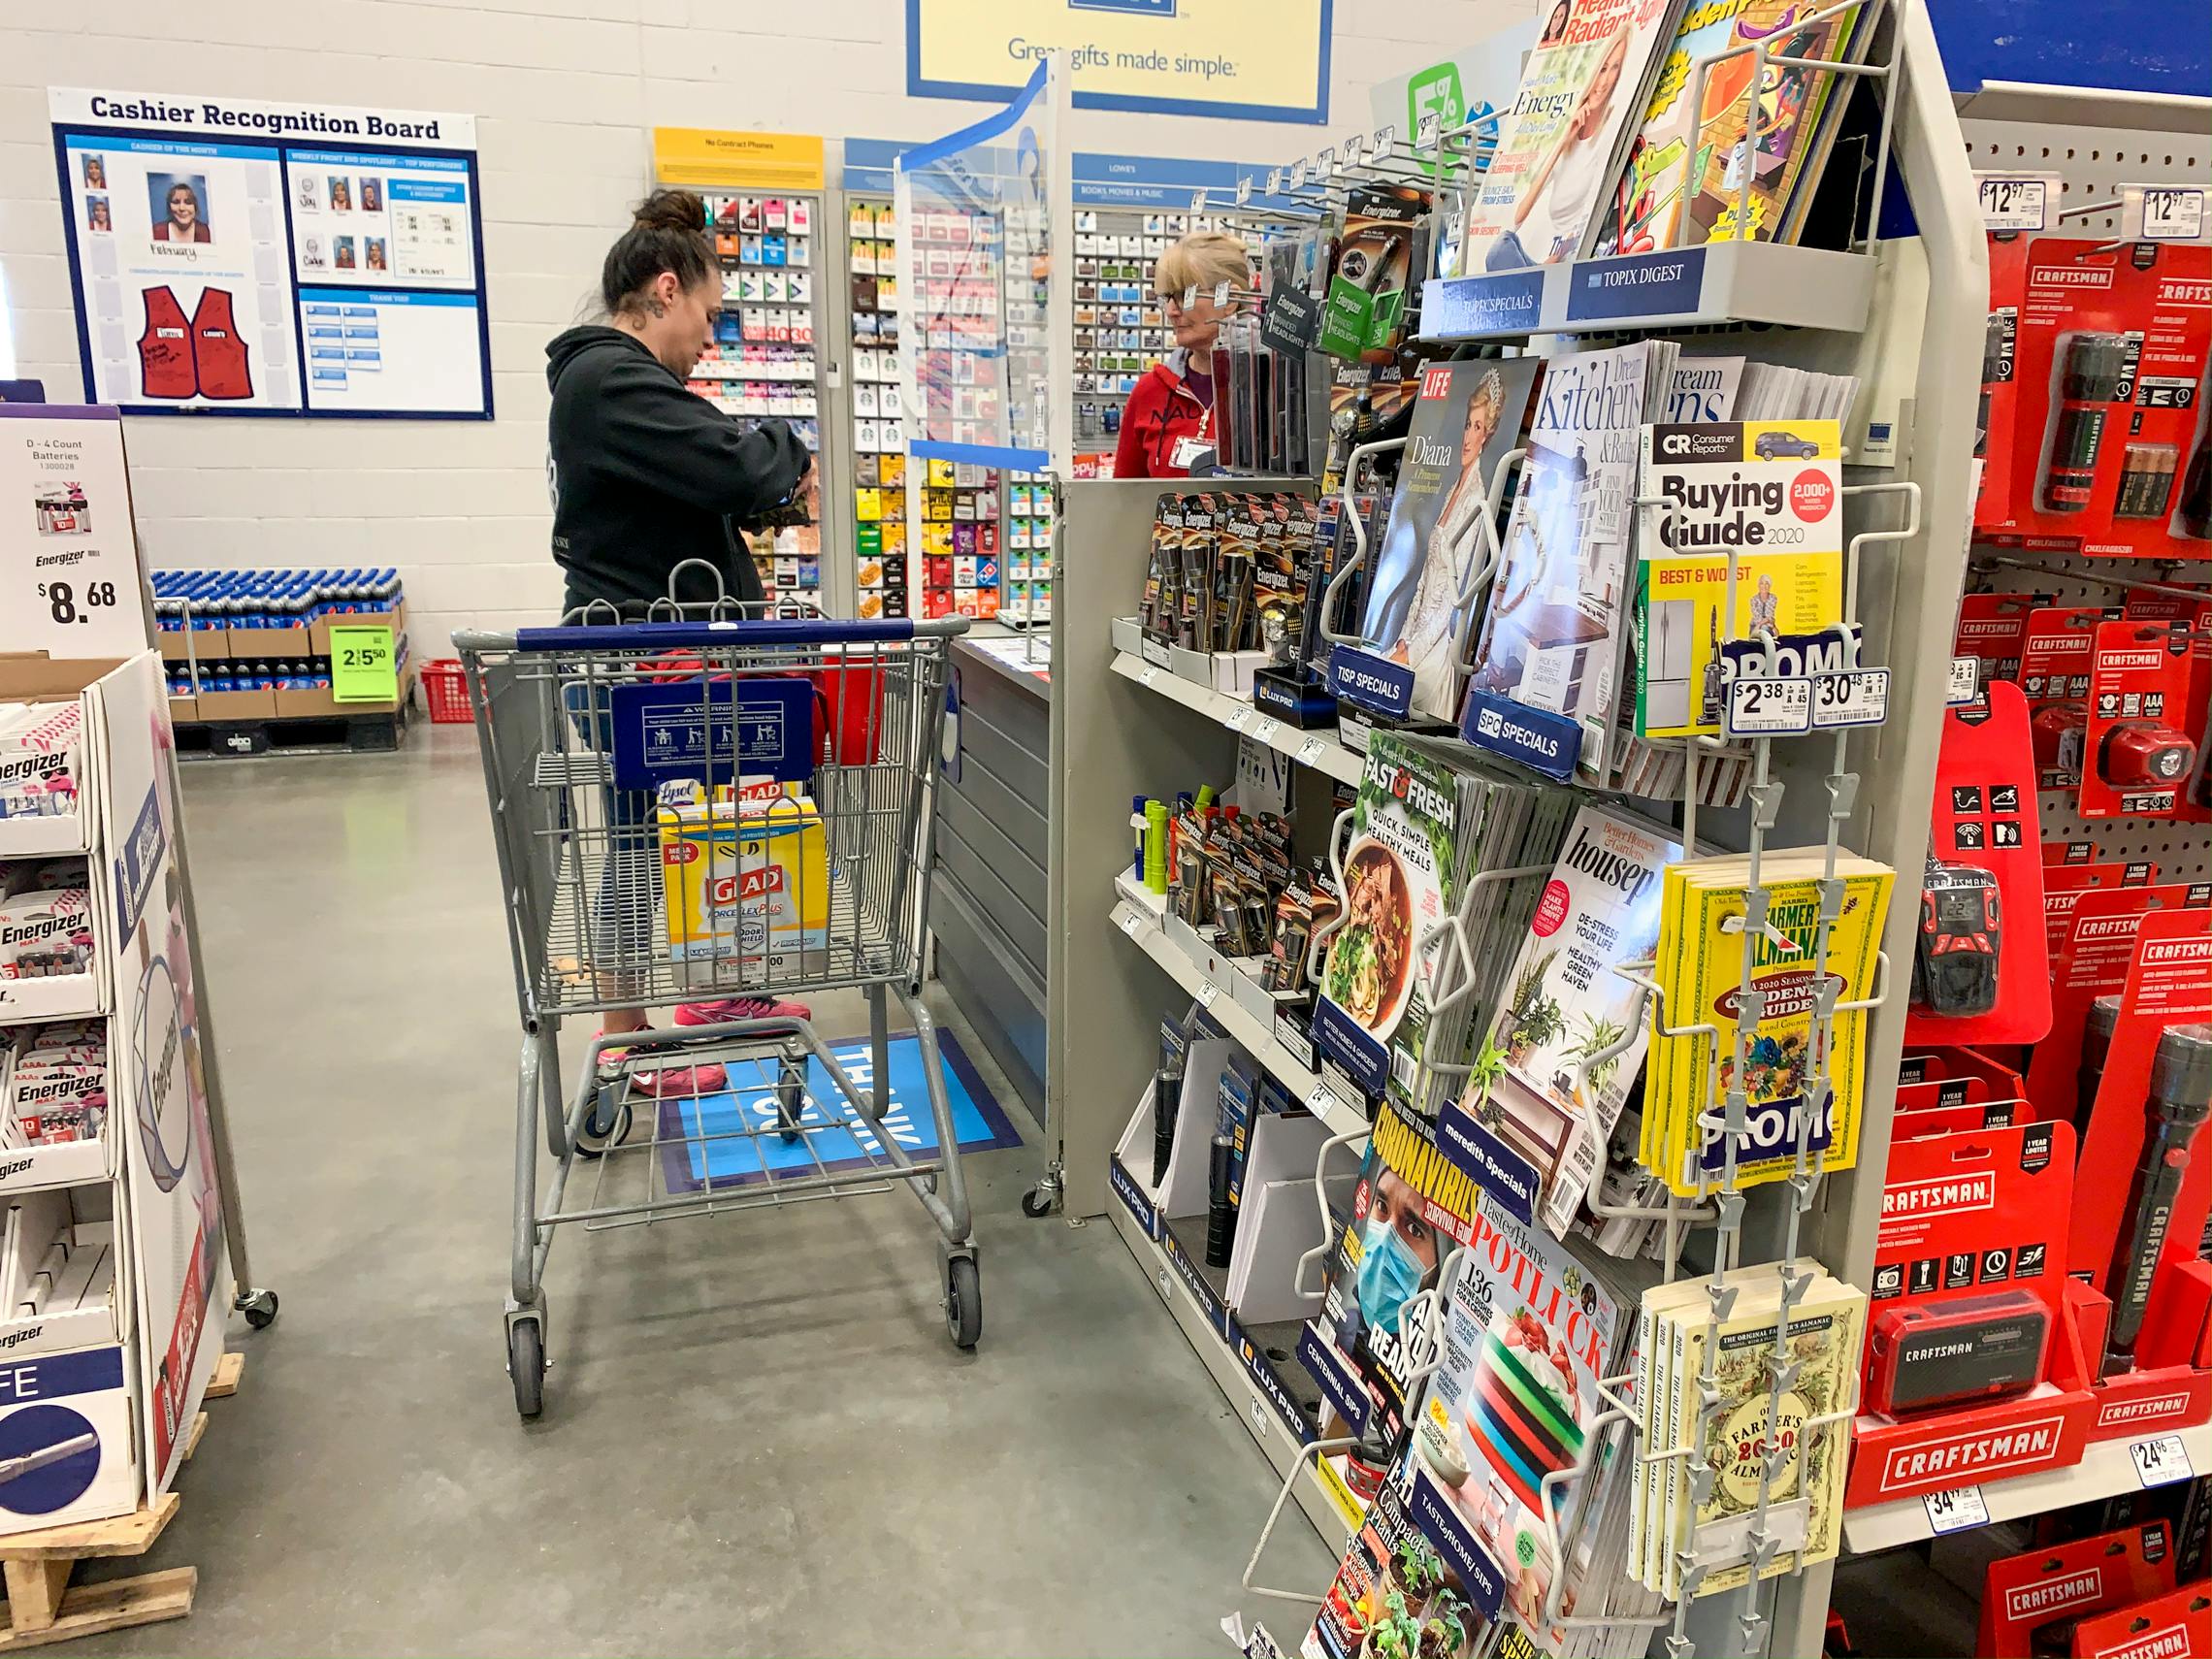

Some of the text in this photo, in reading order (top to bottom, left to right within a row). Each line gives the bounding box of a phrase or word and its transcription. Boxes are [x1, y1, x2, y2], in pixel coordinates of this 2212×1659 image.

[1071, 45, 1109, 71] gifts
[1116, 49, 1168, 72] made
[1512, 90, 1580, 119] Energy
[90, 96, 440, 140] Cashier Recognition Board
[716, 140, 746, 148] Contract
[748, 141, 774, 149] Phones
[1360, 203, 1403, 218] Energizer
[150, 244, 198, 262] February
[1604, 263, 1685, 287] TOPIX DIGEST
[2037, 271, 2108, 283] CRAFTSMAN
[1276, 292, 1307, 319] Energizer
[1334, 290, 1362, 313] Energizer
[1489, 294, 1534, 311] SPECIALS
[1272, 325, 1305, 348] HEADLIGHTS
[1336, 366, 1371, 387] Energizer
[1422, 371, 1452, 397] LIFE
[1673, 368, 1723, 392] ream
[26, 439, 82, 449] D 4 Count
[1410, 436, 1452, 467] Diana
[1662, 434, 1736, 455] CR Consumer
[1692, 442, 1728, 455] Reports
[2086, 414, 2102, 465] CRAFTSMAN
[33, 451, 80, 461] Batteries
[40, 462, 75, 471] 1300028
[1662, 472, 1784, 517] Buying
[1794, 483, 1831, 498] 2,000+
[1185, 510, 1212, 530] Energizer
[1226, 518, 1259, 539] Energizer
[1660, 510, 1805, 548] Guide 2020
[36, 549, 85, 568] Energizer
[1256, 567, 1289, 589] Energizer
[1660, 566, 1752, 585] BEST & WOST
[1963, 622, 2018, 634] CRAFTSMAN
[2032, 637, 2088, 650] CRAFTSMAN
[342, 649, 355, 666] 2
[2101, 654, 2159, 667] CRAFTSMAN
[1337, 665, 1400, 701] TISP SPECIALS
[1636, 669, 1645, 695] 2020
[2144, 694, 2163, 708] AAA
[1479, 710, 1558, 759] SPC SPECIALS
[660, 780, 695, 800] Lysol
[1364, 754, 1455, 831] FAST FRESH
[1178, 812, 1204, 843] Energizer
[1372, 808, 1431, 853] QUICK, SIMPLE
[1366, 823, 1431, 872] HEALTHY MEALS
[1233, 855, 1261, 882] Energizer
[1927, 877, 1988, 888] CRAFTSMAN
[1542, 898, 1565, 916] PLANTS
[1545, 893, 1563, 905] MAKE
[1540, 906, 1561, 923] THRIVE
[1578, 912, 1619, 940] DE-STRESS
[2, 911, 85, 945] Energizer
[1575, 924, 1614, 952] YOUR LIFE
[19, 936, 40, 947] MAX
[1566, 959, 1594, 981] GREEN
[1567, 946, 1603, 971] HEALTHY
[1561, 970, 1589, 992] HAVEN
[1759, 979, 1779, 990] 2020
[1765, 1018, 1811, 1031] and Country
[17, 1072, 104, 1103] Energizer
[2032, 1138, 2048, 1148] YEAR
[1372, 1100, 1485, 1223] CORONAVIRUS
[1445, 1122, 1529, 1201] meredith Specials
[1882, 1180, 1991, 1214] RAFTSMAN
[1424, 1200, 1457, 1236] SURVIVAL
[1483, 1193, 1511, 1236] Taste
[1513, 1231, 1548, 1272] Home
[2131, 1205, 2170, 1304] CRAFTSMAN
[1464, 1261, 1496, 1304] 136
[1455, 1287, 1490, 1327] FOR CROWD
[1457, 1278, 1494, 1319] DIVINE DISHES
[1468, 1211, 1609, 1382] POTLUCK
[1738, 1330, 1768, 1343] ORIGINAL
[1800, 1317, 1832, 1330] ALMANAC
[1905, 1341, 1973, 1363] CRAFTSMAN
[1307, 1342, 1346, 1401] CENTENNIAL
[1345, 1393, 1362, 1421] SIPS
[2104, 1397, 2183, 1420] CRAFTSMAN
[1894, 1428, 2051, 1480] CRAFTSMAN
[1367, 1505, 1400, 1556] Plants
[1379, 1488, 1426, 1556] Compact
[1340, 1567, 1360, 1601] Scraps
[1346, 1557, 1369, 1595] Kitchen
[1473, 1567, 1494, 1597] SIPS
[2012, 1577, 2095, 1611] CRAFTSMAN
[1321, 1607, 1352, 1657] Henhouse?
